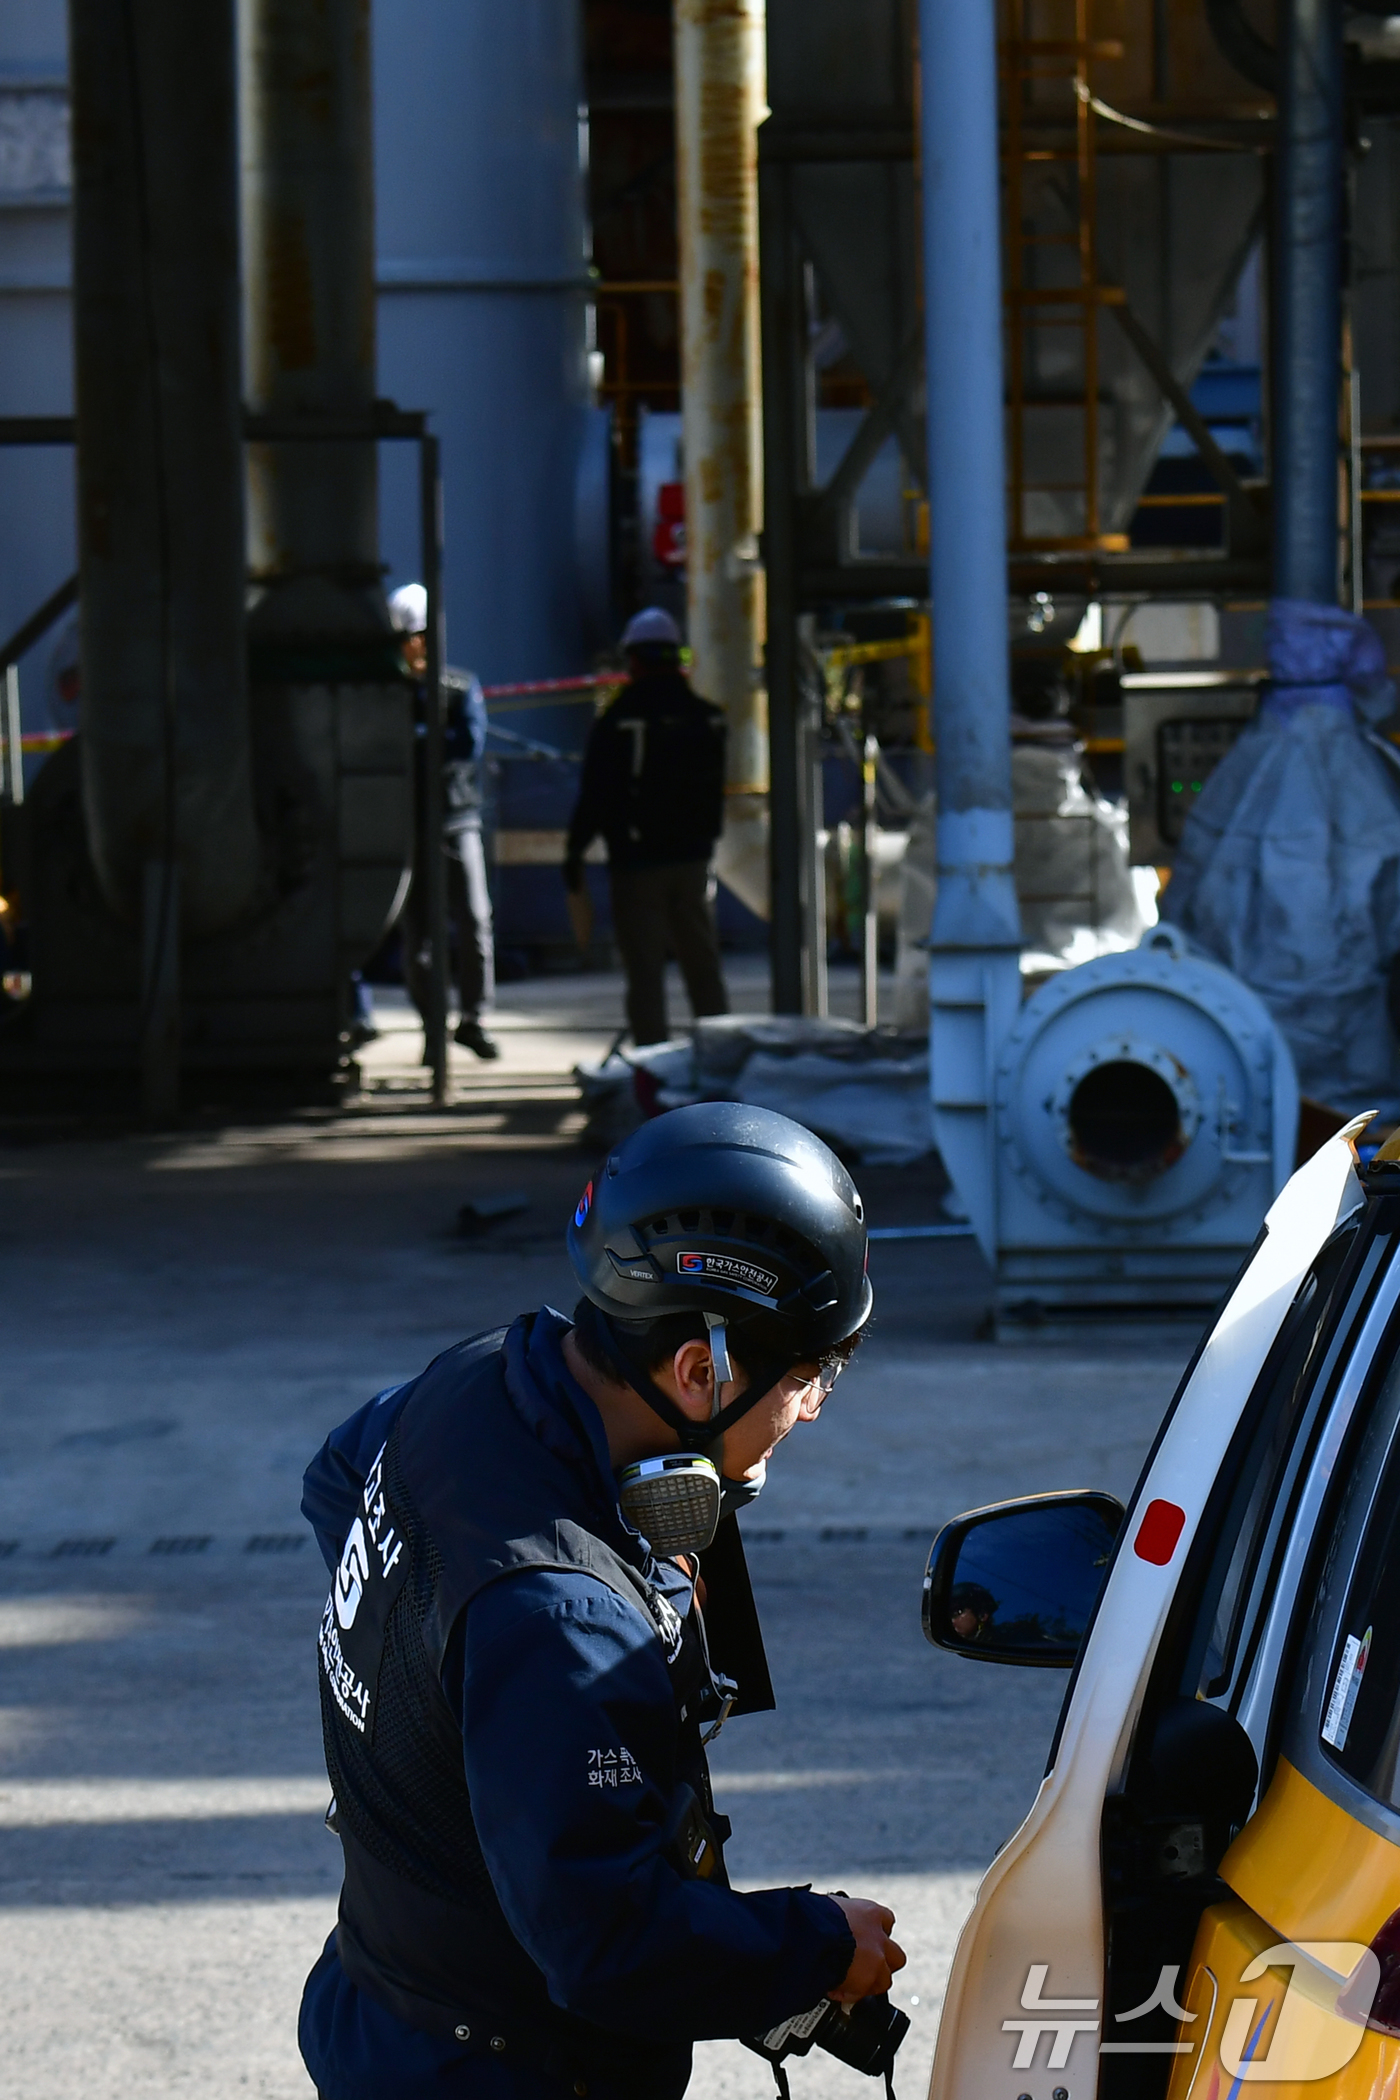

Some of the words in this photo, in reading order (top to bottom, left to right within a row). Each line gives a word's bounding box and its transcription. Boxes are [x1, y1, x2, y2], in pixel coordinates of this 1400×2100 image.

[629, 1269, 654, 1280] VERTEX
[705, 1256, 773, 1287] 한국가스안전공사
[587, 1748, 618, 1768] 가스
[587, 1768, 618, 1789] 화재
